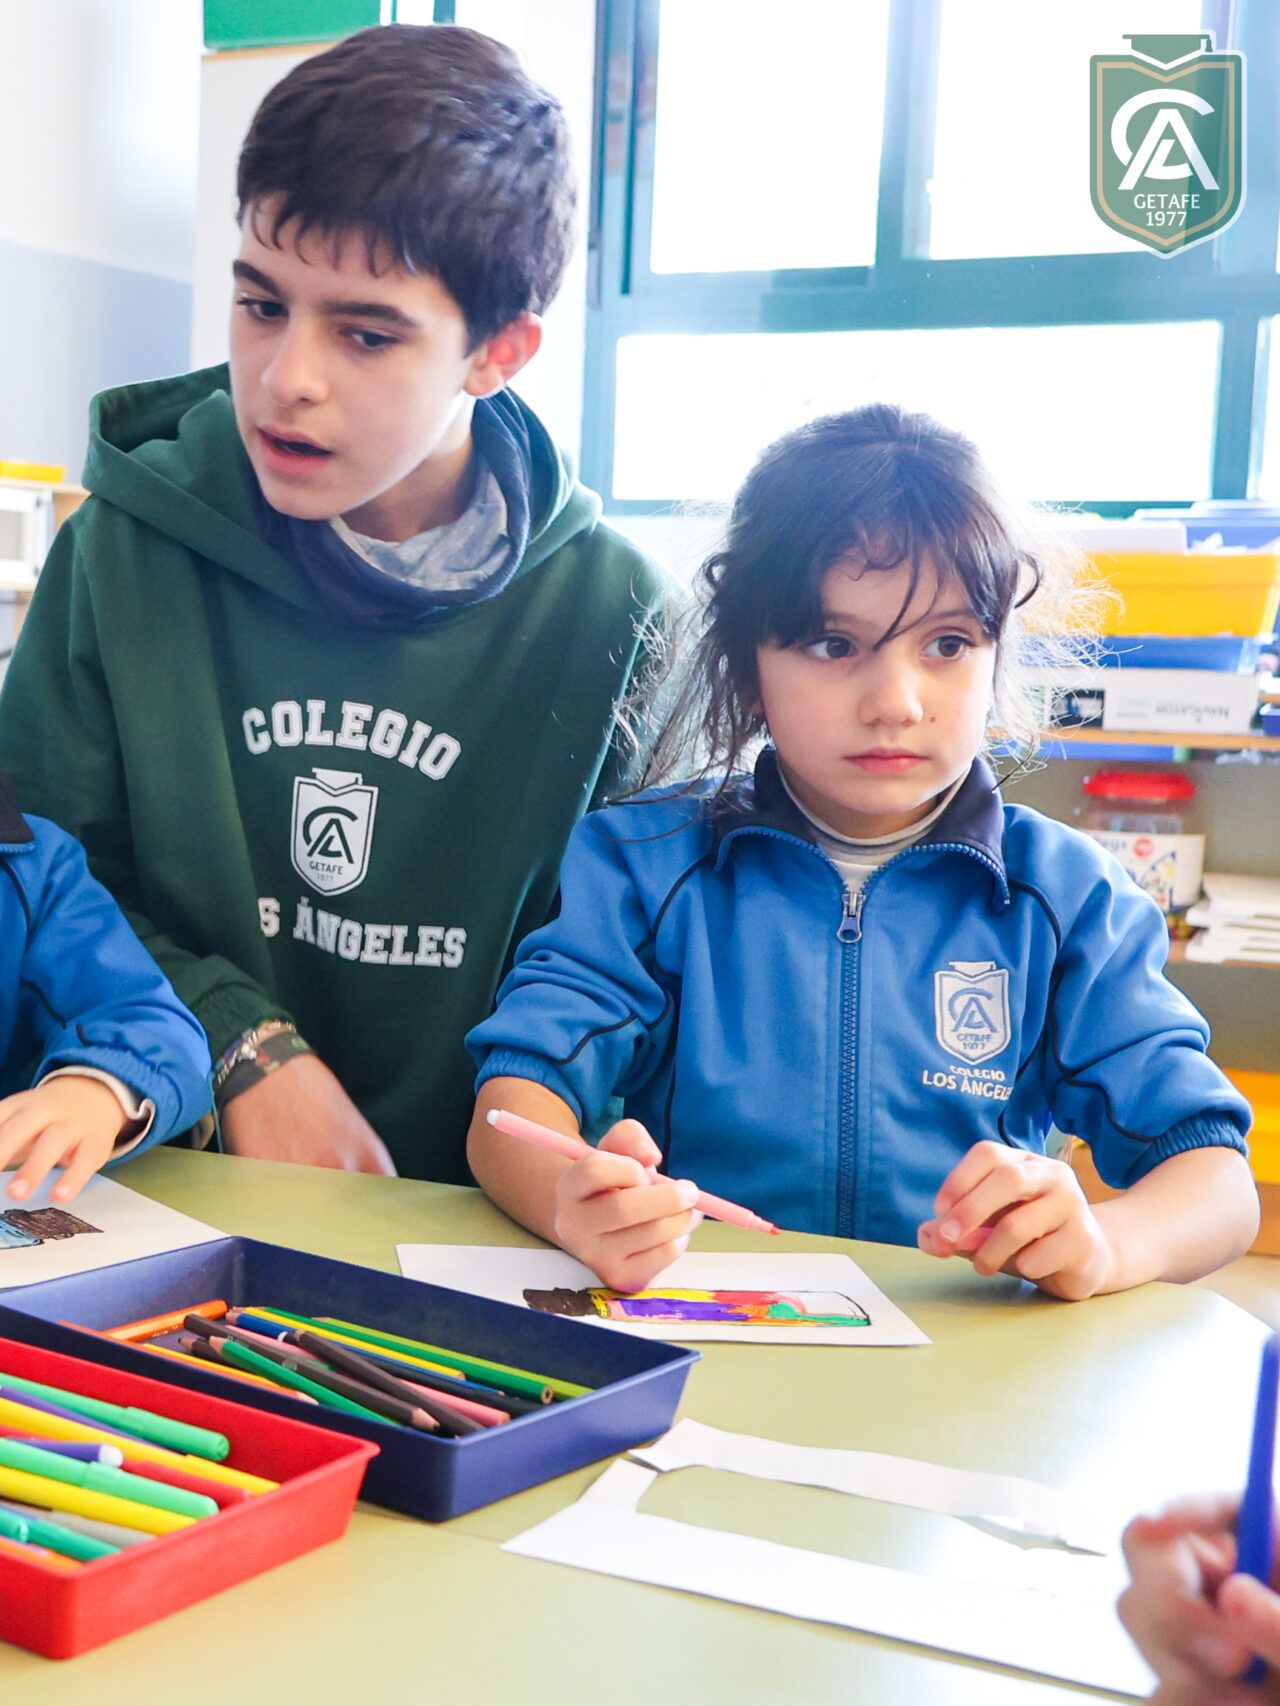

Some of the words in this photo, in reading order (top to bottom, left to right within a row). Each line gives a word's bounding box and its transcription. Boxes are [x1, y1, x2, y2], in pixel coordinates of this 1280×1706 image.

[242, 699, 462, 781] COLEGIO
[309, 860, 344, 876] GETAFE
[293, 896, 468, 969] ÁNGELES
[922, 1070, 957, 1090] LOS
[950, 1065, 1005, 1080] COLEGIO
